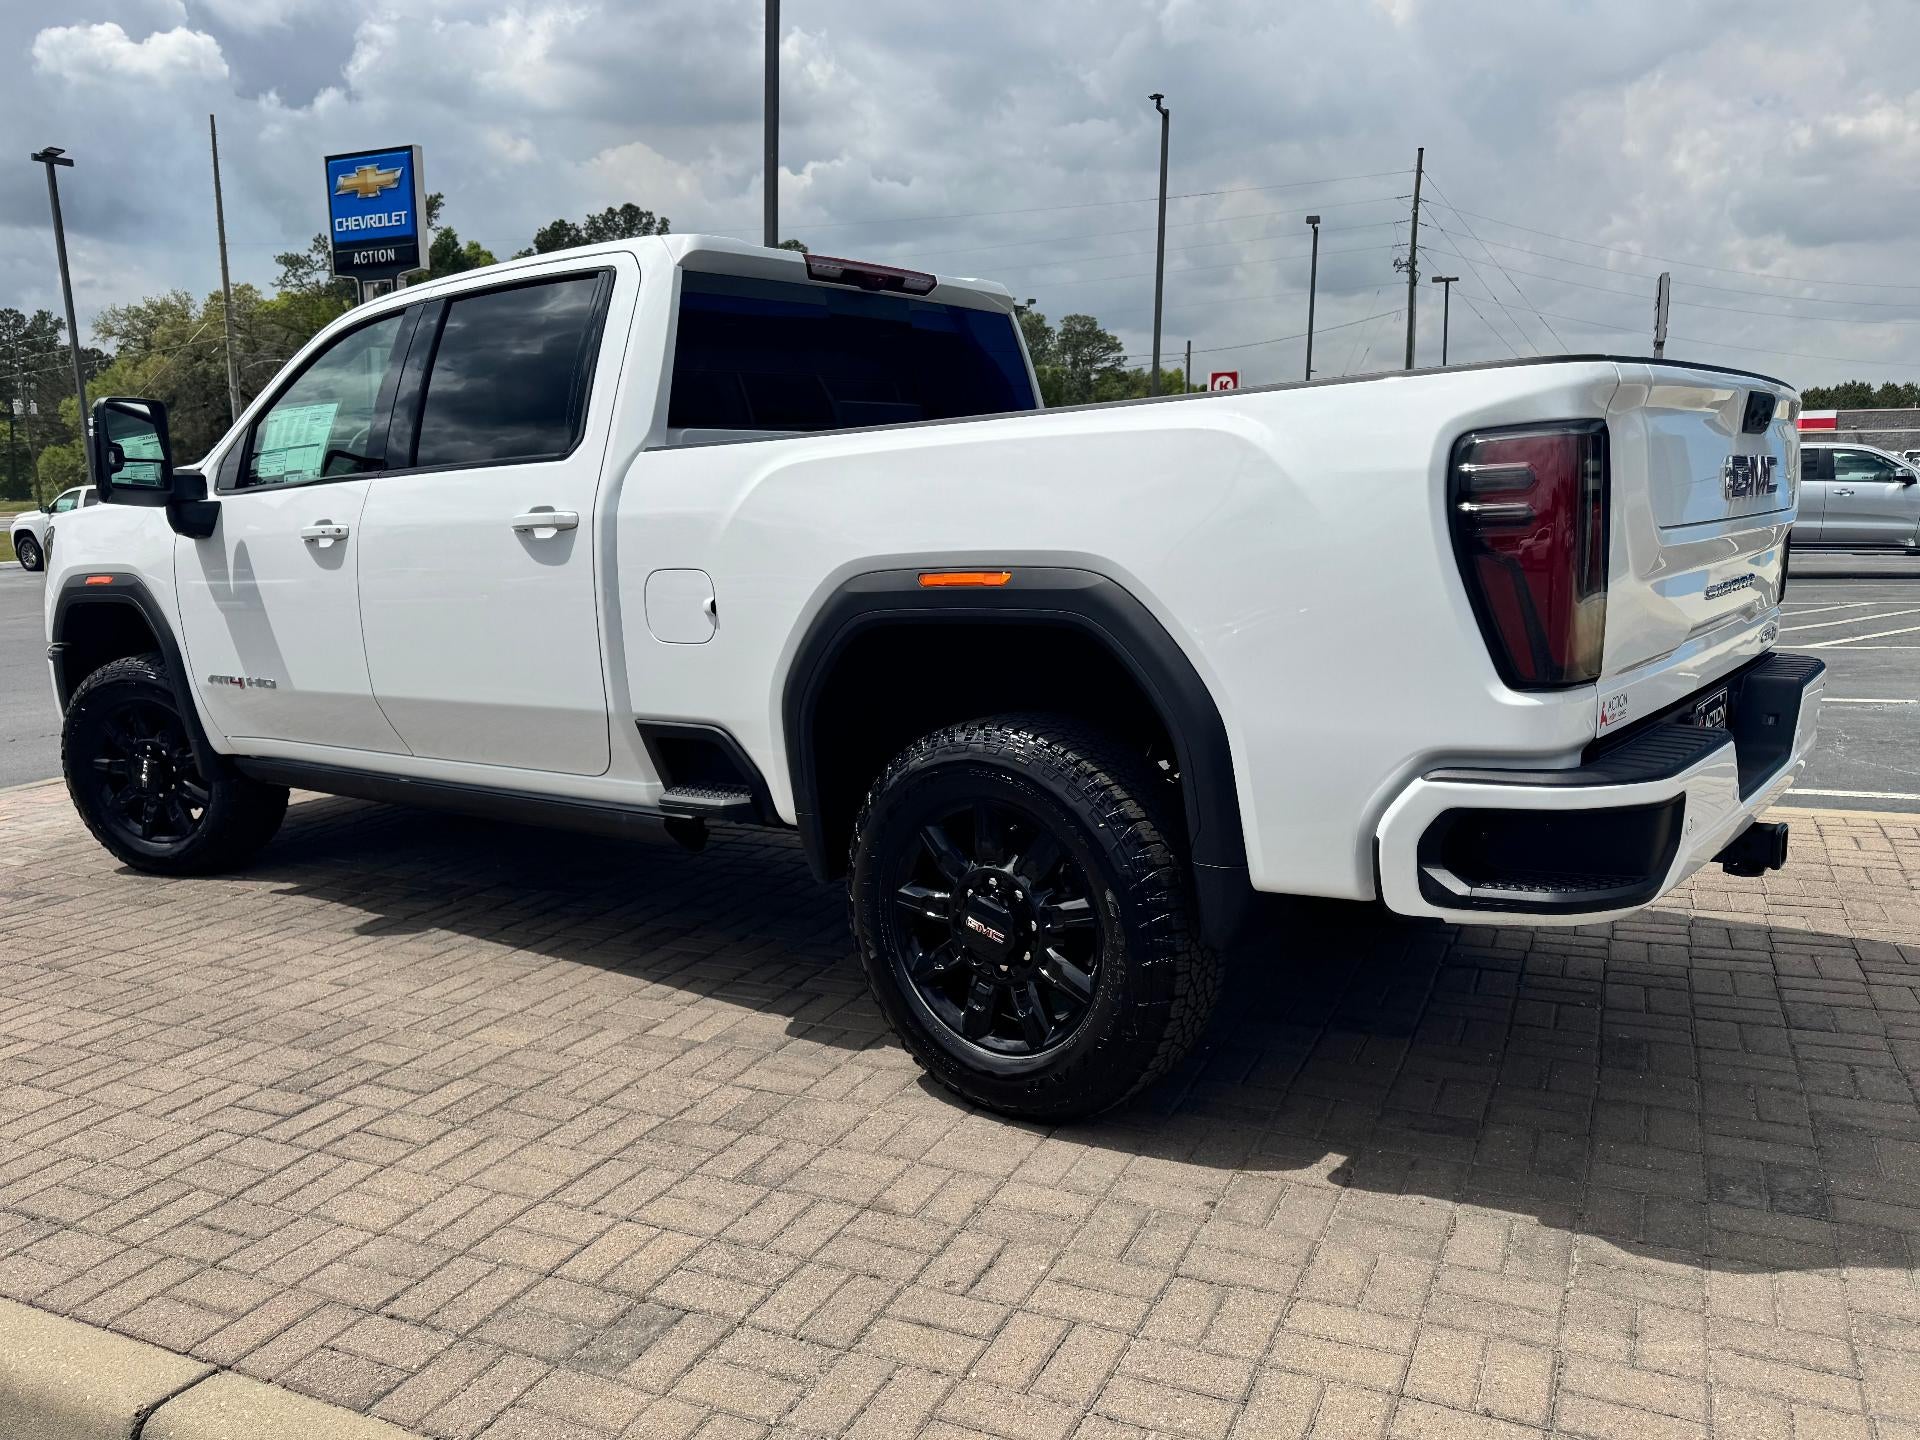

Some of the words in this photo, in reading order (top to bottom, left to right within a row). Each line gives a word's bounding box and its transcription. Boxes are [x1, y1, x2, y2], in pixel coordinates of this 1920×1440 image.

[335, 211, 407, 232] CHEVROLET
[353, 248, 396, 265] ACTION
[1219, 380, 1231, 391] K
[1724, 454, 1779, 501] GMC
[966, 915, 1005, 944] GMC
